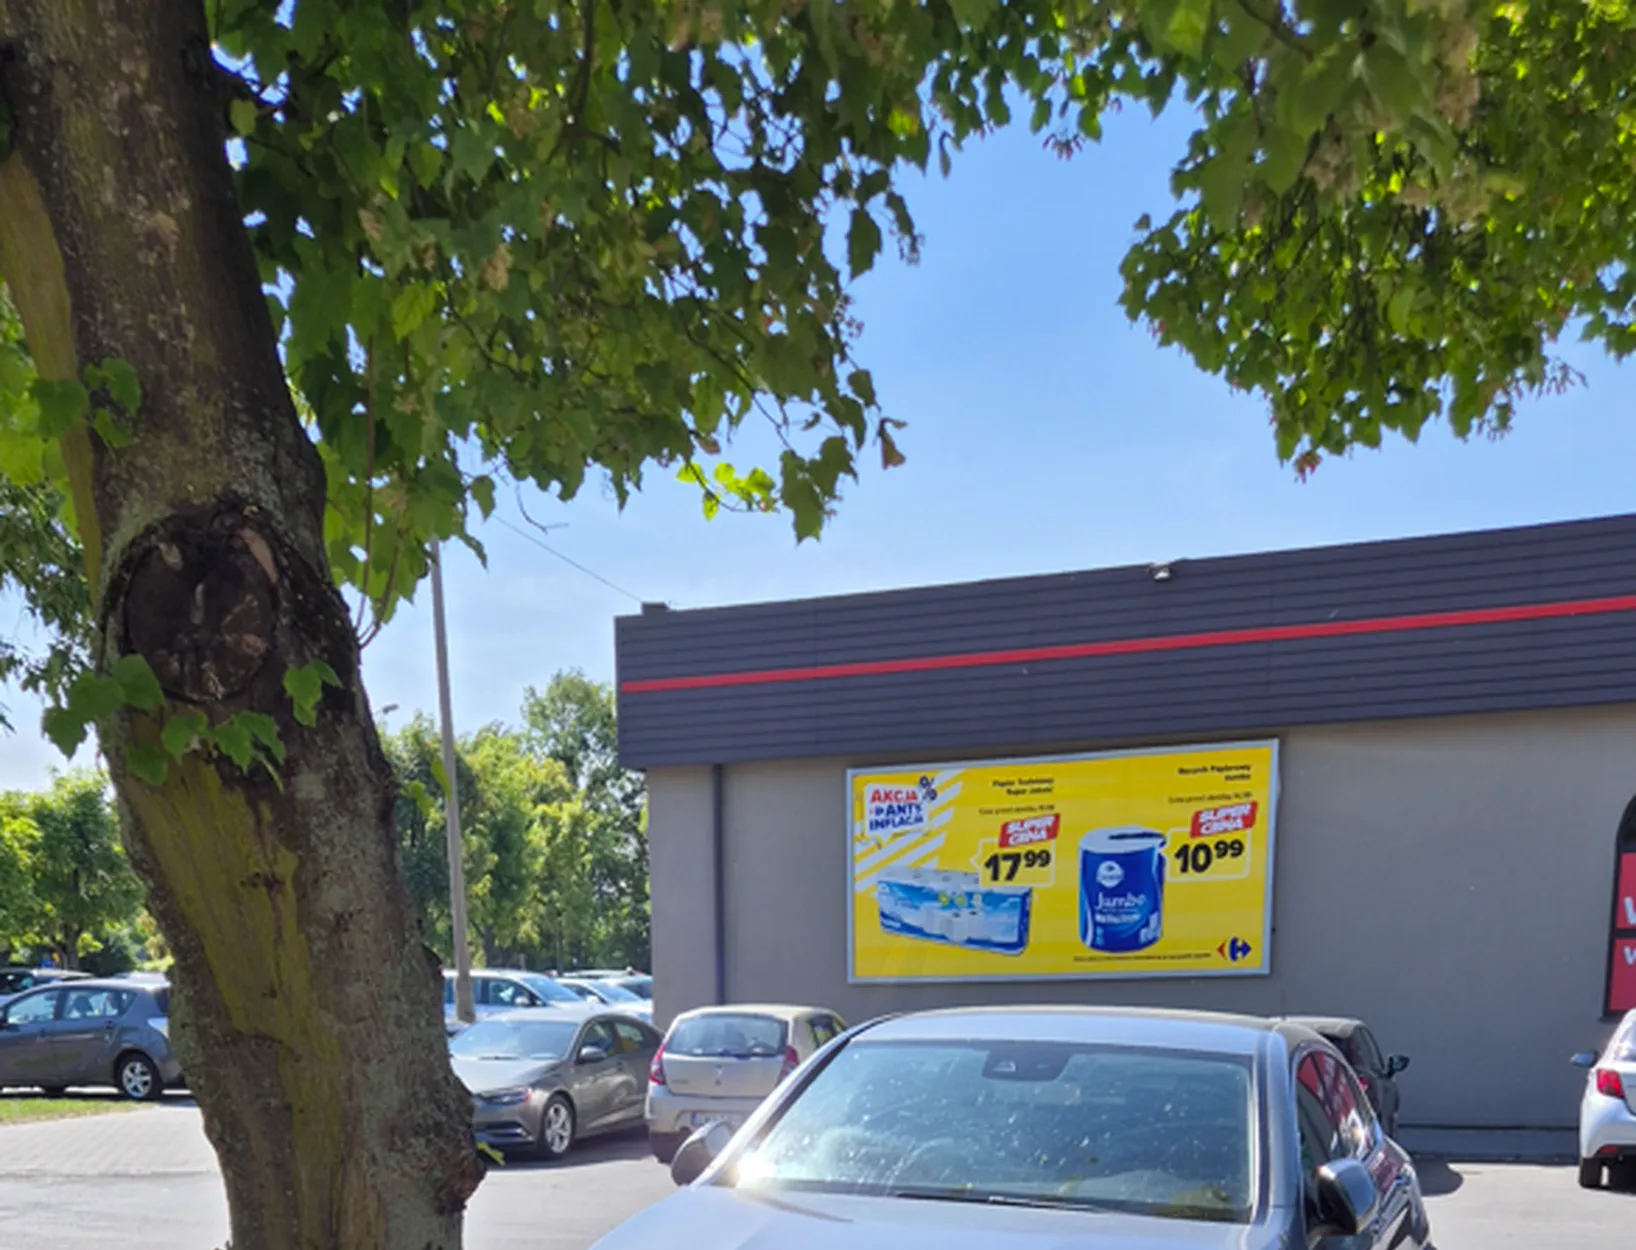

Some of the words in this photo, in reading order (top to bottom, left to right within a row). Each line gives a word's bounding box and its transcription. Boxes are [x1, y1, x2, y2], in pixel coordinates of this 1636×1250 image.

[871, 788, 918, 803] AKCJA
[1199, 803, 1252, 823] SUPER
[1006, 815, 1054, 834] SUPER
[1008, 828, 1048, 846] CENA
